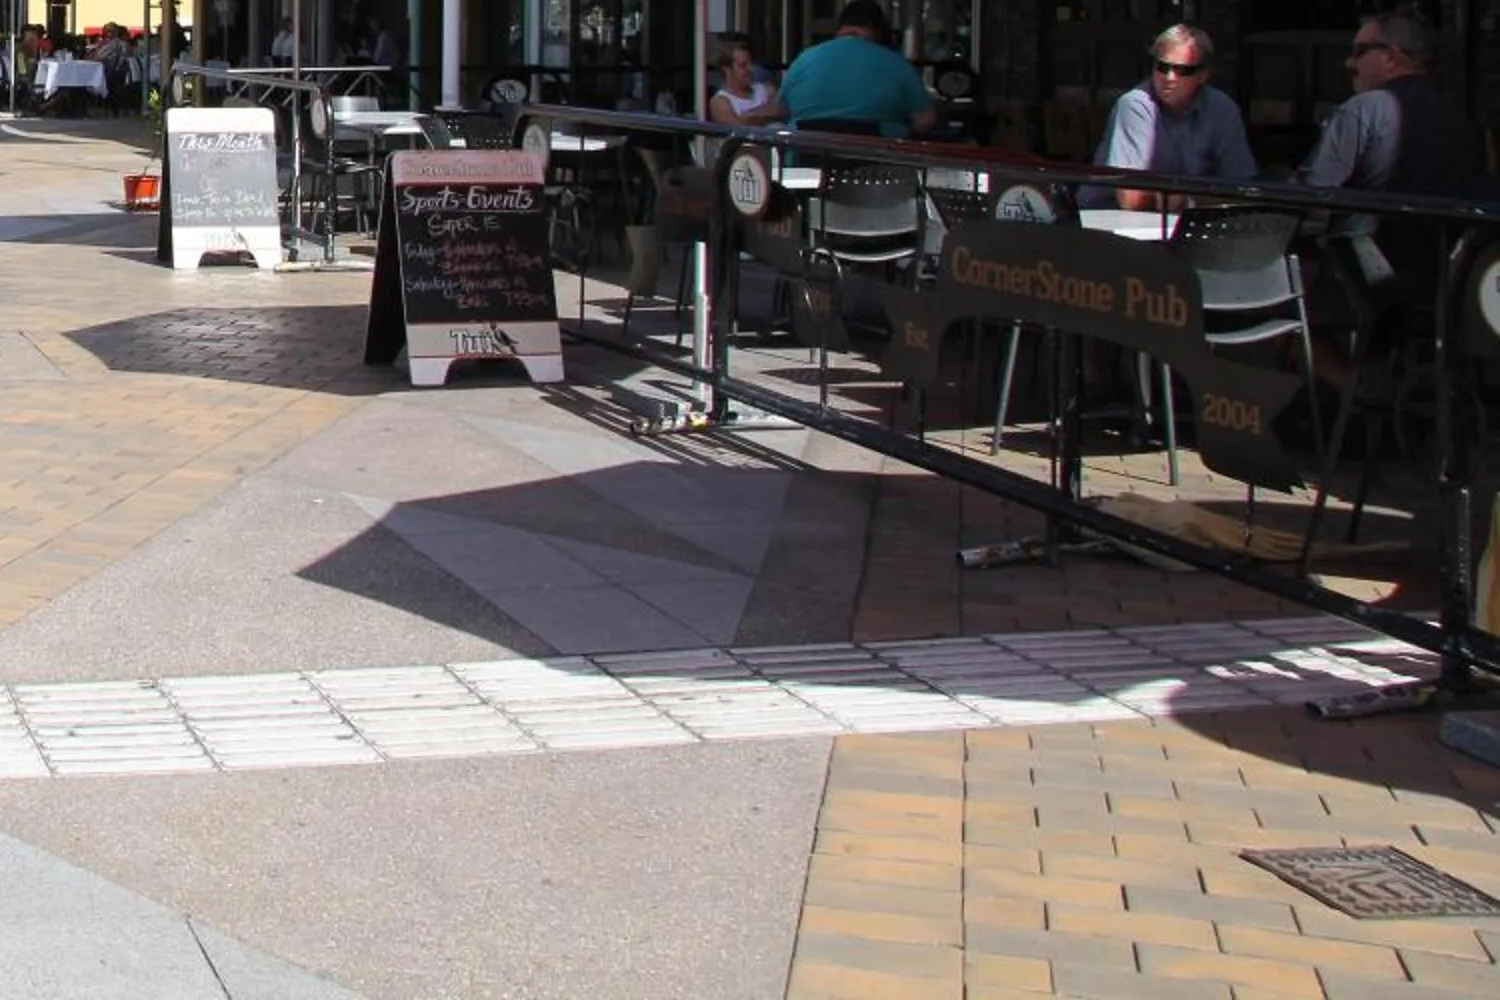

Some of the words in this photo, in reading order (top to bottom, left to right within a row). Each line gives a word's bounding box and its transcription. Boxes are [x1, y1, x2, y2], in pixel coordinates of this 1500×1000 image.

[401, 186, 459, 215] Sports
[467, 185, 533, 210] Events
[952, 246, 1115, 312] CornerStone
[1125, 277, 1189, 327] Pub
[1203, 392, 1261, 435] 2004
